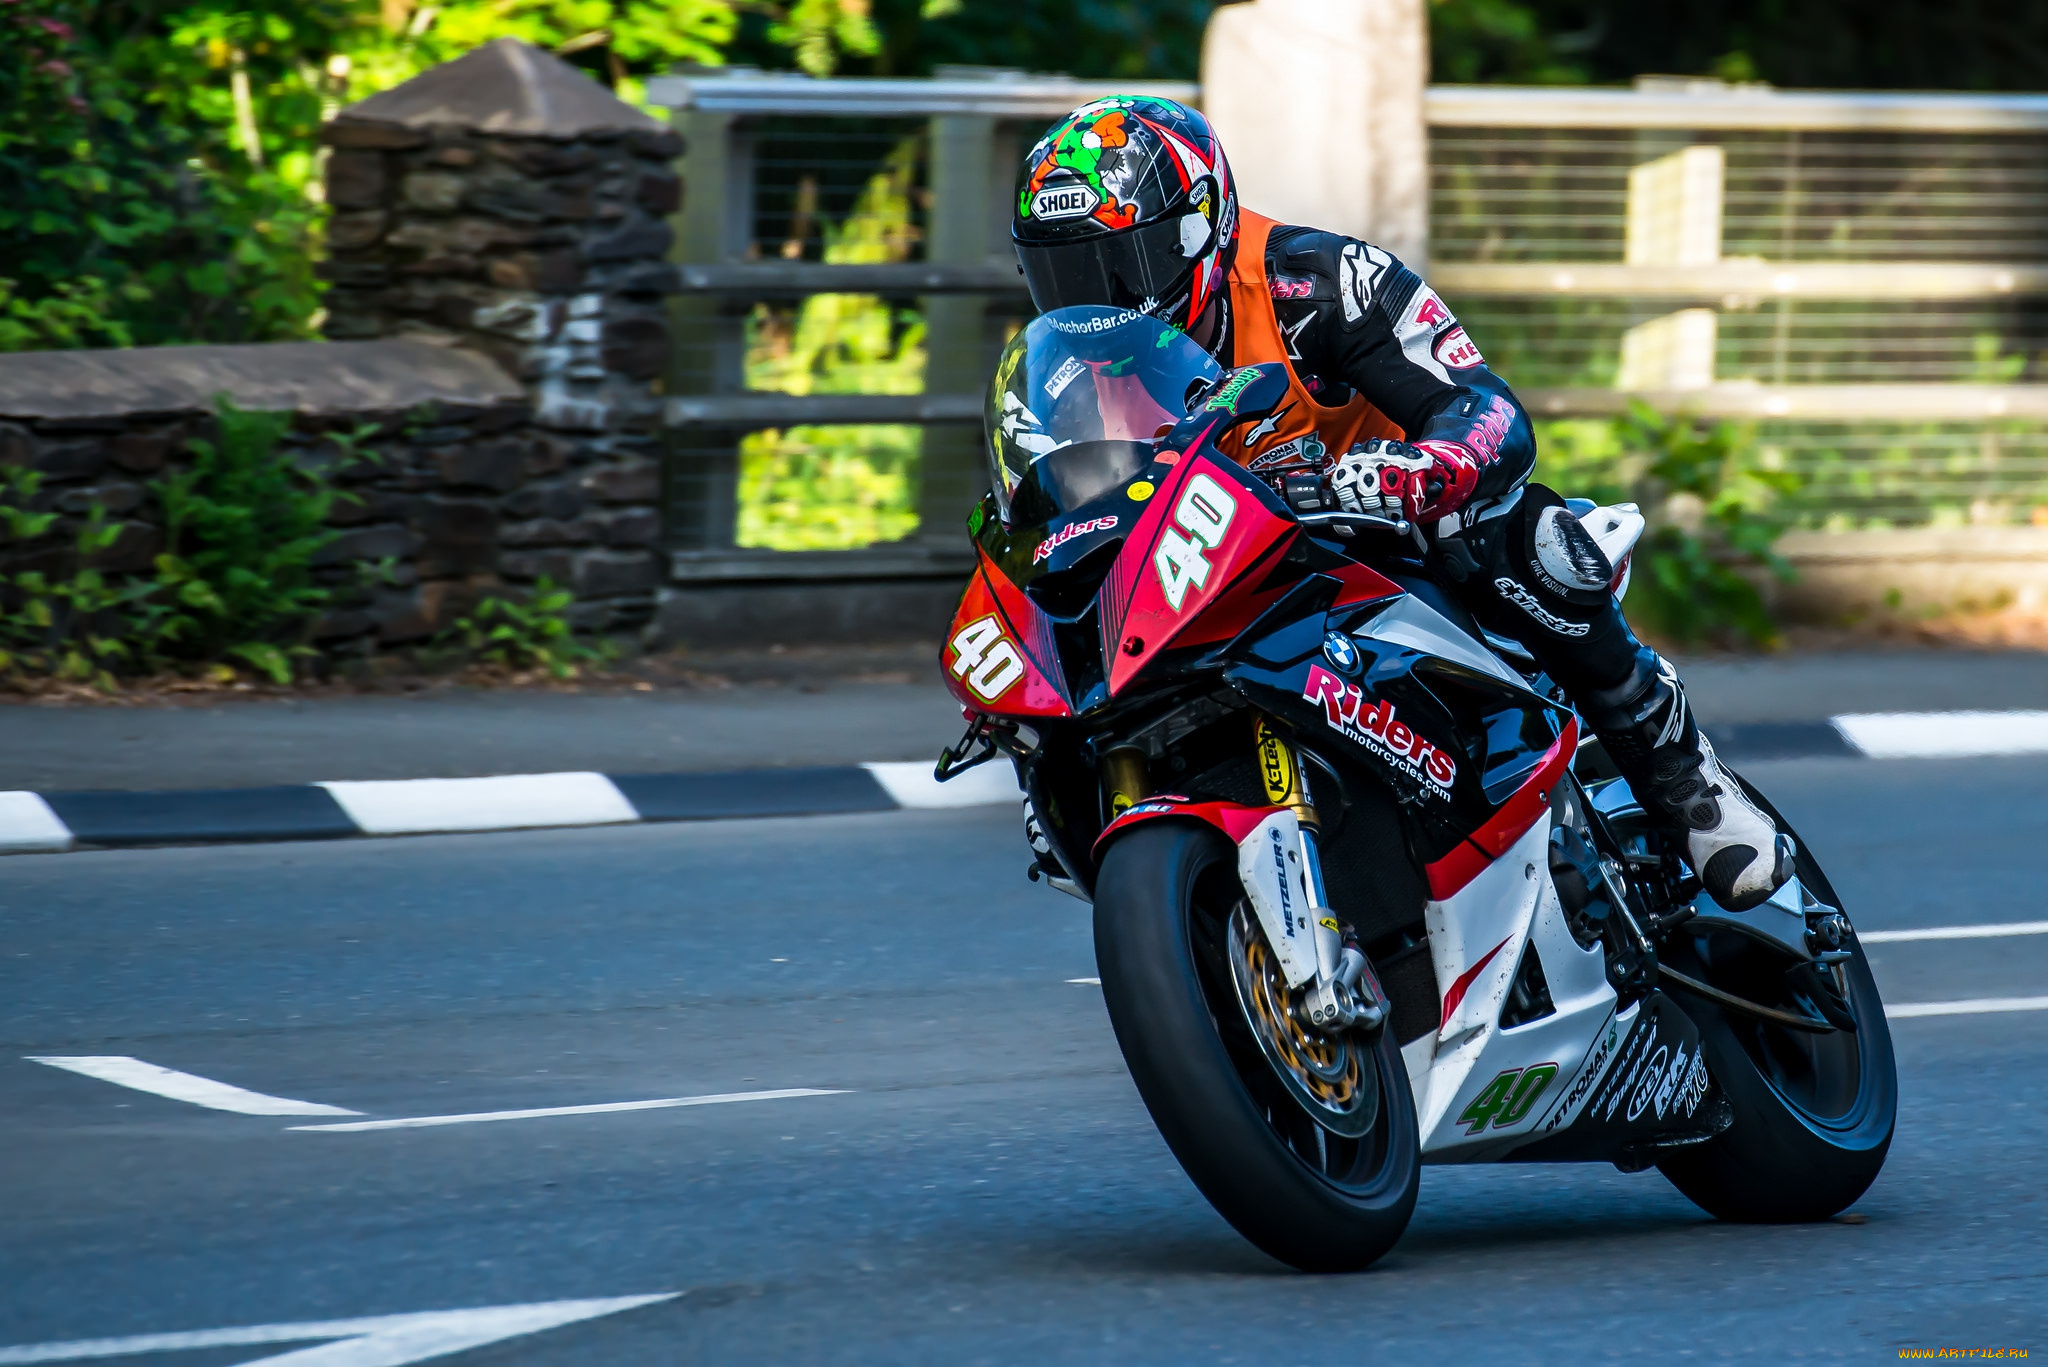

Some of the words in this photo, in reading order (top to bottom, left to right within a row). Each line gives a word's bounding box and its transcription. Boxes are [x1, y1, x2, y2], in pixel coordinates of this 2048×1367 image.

[1040, 192, 1086, 213] SHOEI
[1191, 183, 1207, 203] SHOEI
[1448, 342, 1478, 365] HE
[1249, 442, 1297, 470] PETRONAS
[1465, 394, 1517, 466] Riders
[1033, 515, 1118, 565] Riders
[1155, 473, 1236, 611] 40
[1541, 574, 1569, 598] VISION.
[950, 613, 1026, 704] 40
[1260, 723, 1285, 793] K-tech
[1303, 664, 1457, 789] Riders
[1345, 727, 1451, 802] motorcycles.com
[1274, 844, 1295, 938] METZELER
[1455, 1062, 1559, 1136] 40
[1545, 1040, 1607, 1133] PETRONAS
[1591, 1035, 1639, 1118] METZELER
[1635, 1064, 1660, 1111] HEL
[1654, 1040, 1686, 1118] RK
